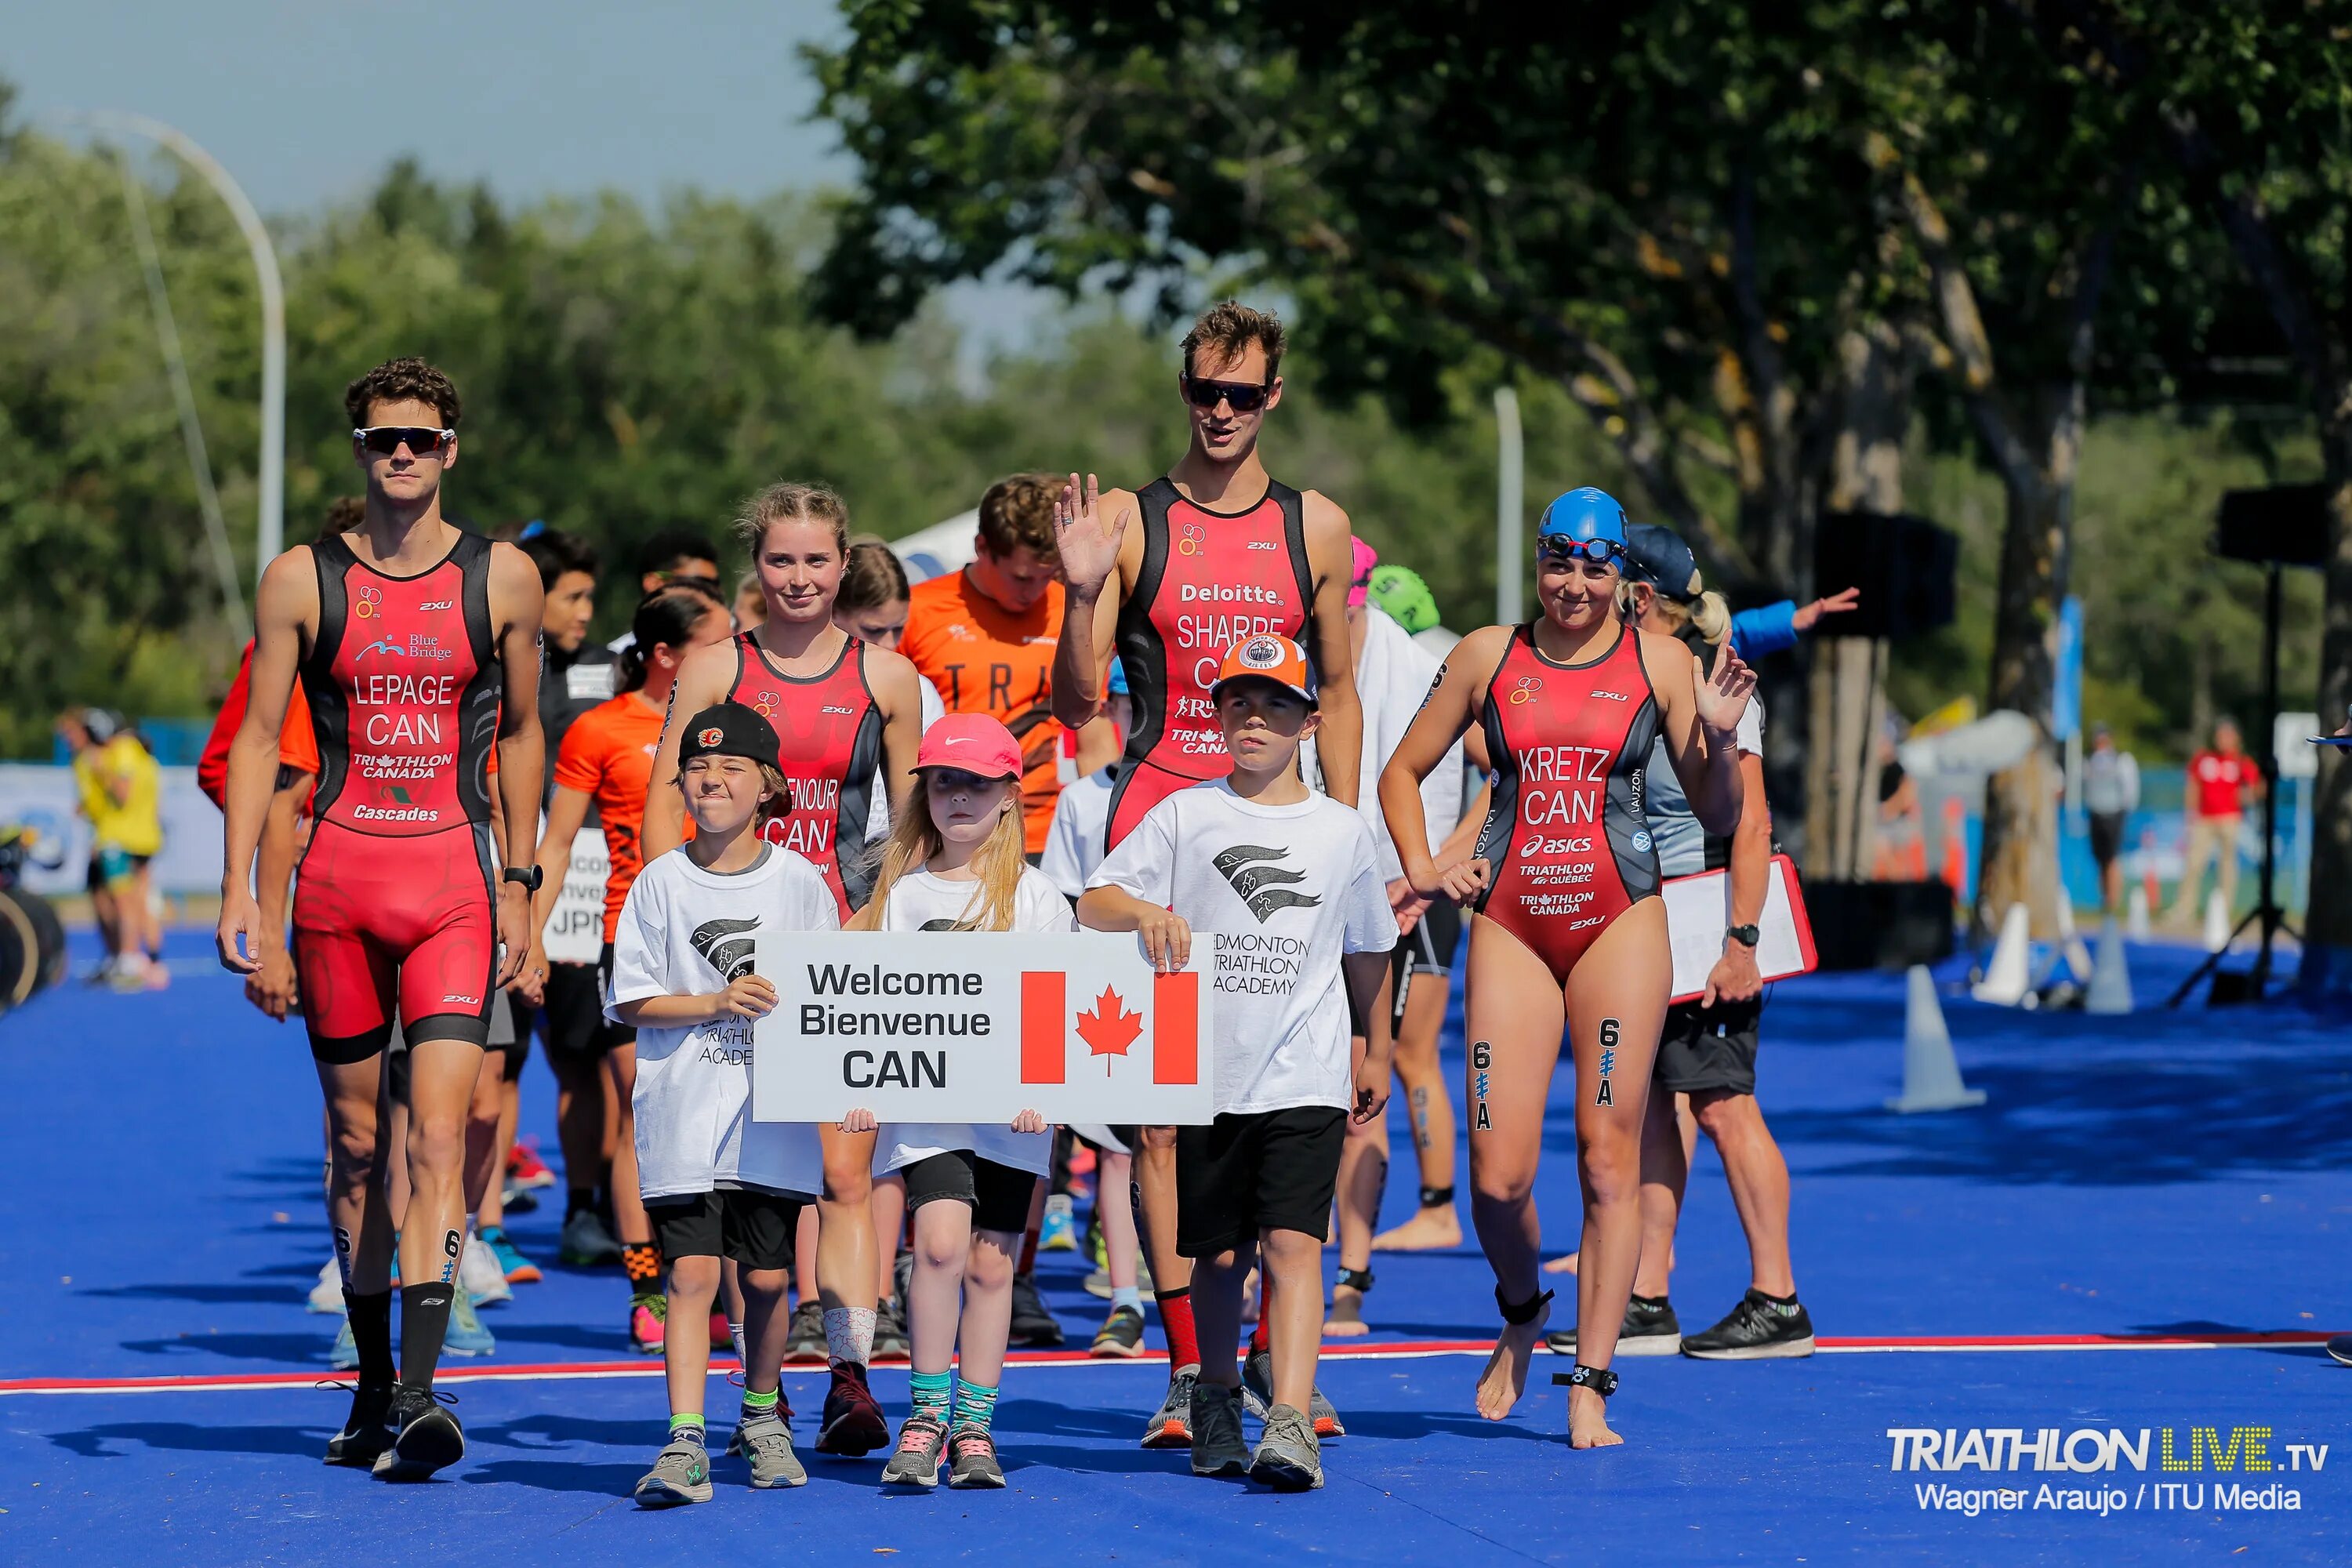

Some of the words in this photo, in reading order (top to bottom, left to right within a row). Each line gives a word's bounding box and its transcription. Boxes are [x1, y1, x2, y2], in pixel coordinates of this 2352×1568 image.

[1247, 541, 1277, 550] 2XU
[419, 600, 453, 611] 2XU
[409, 633, 438, 646] Blue
[409, 645, 452, 661] Bridge
[354, 674, 455, 705] LEPAGE
[1590, 690, 1628, 702] 2XU
[822, 706, 854, 715] 2XU
[366, 713, 441, 746] CAN
[354, 753, 453, 768] TRITHLON
[1518, 746, 1610, 783] KRETZ
[362, 766, 435, 779] CANADA
[786, 778, 838, 811] ENOUR
[1631, 768, 1642, 813] LAUZON
[354, 804, 438, 822] Cascades
[1525, 789, 1596, 826] CAN
[764, 817, 829, 853] CAN
[1542, 837, 1592, 855] asics
[1519, 862, 1595, 877] TRIATHLON
[1519, 891, 1595, 906] TRITHLON
[1530, 903, 1580, 916] CANADA
[1569, 915, 1606, 931] 2XU
[1214, 954, 1301, 976] TRIATHLON
[807, 964, 983, 995] Welcome
[1213, 975, 1297, 996] ACADEMY
[442, 995, 479, 1004] 2XU
[800, 1004, 991, 1036] Bienvenue
[1599, 1018, 1621, 1048] 6
[699, 1046, 754, 1066] ACADE
[1472, 1040, 1492, 1071] 6
[843, 1050, 946, 1088] CAN
[1595, 1078, 1613, 1106] A
[1475, 1102, 1493, 1131] A
[444, 1228, 461, 1260] 6
